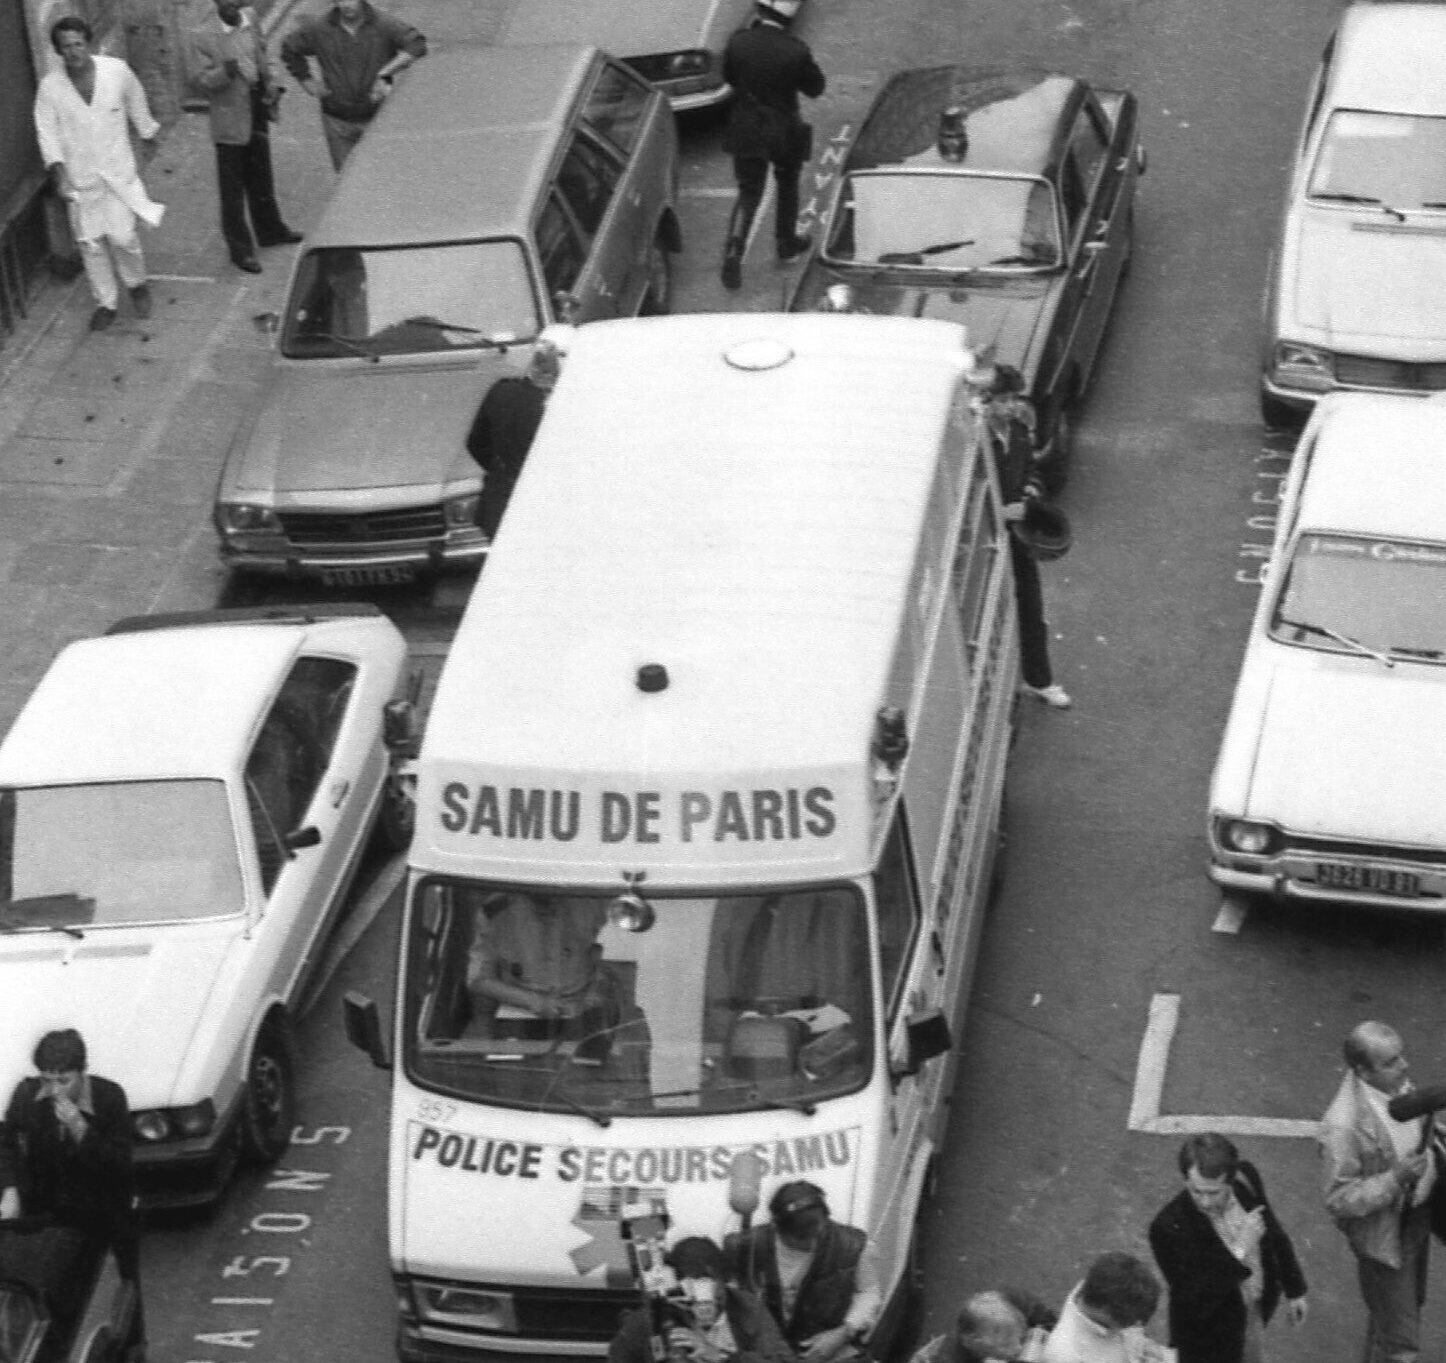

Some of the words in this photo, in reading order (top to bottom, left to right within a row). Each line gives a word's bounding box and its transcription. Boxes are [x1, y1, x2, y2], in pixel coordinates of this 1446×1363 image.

[441, 782, 579, 842] SAMU
[600, 790, 661, 844] DE
[680, 785, 838, 844] PARIS
[413, 1127, 543, 1179] POLICE
[556, 1144, 731, 1186] SECOURS
[750, 1130, 851, 1179] SAMU
